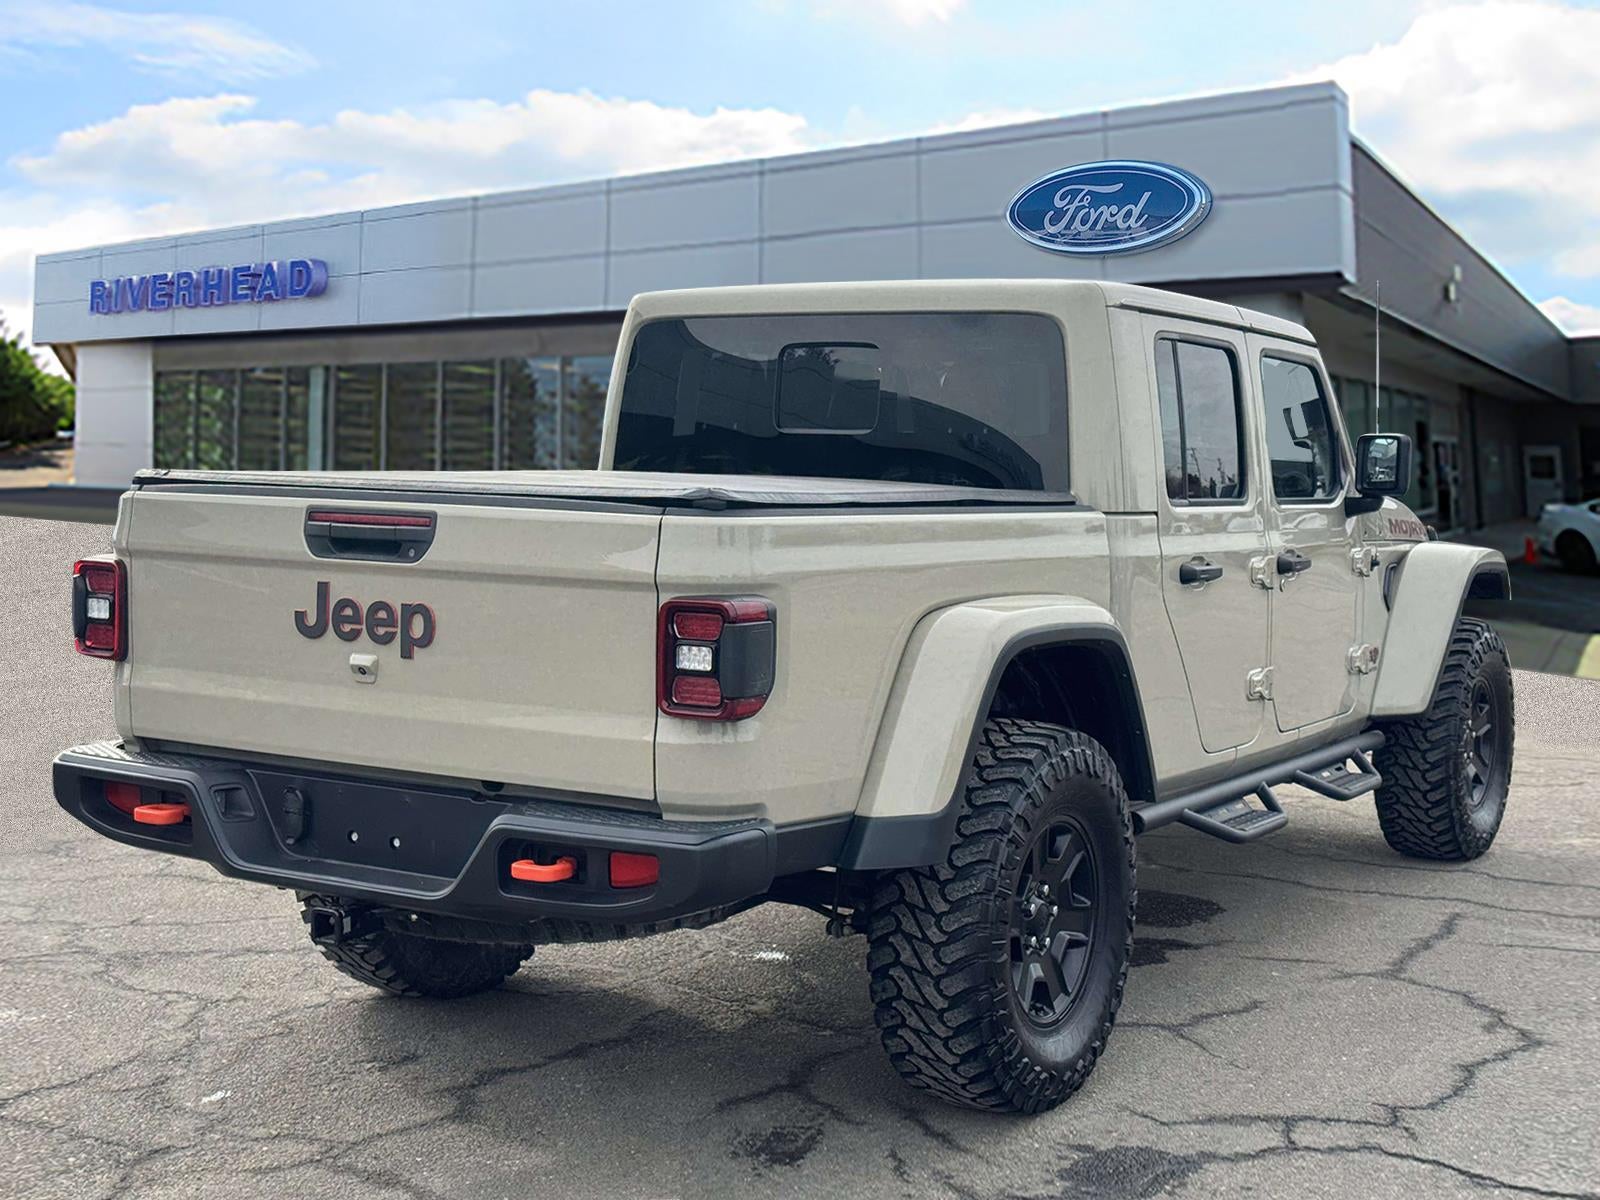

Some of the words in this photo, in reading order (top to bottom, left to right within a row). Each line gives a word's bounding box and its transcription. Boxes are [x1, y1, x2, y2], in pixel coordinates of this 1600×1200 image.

[1043, 183, 1152, 234] Ford
[89, 259, 328, 315] RIVERHEAD
[294, 581, 436, 660] Jeep
